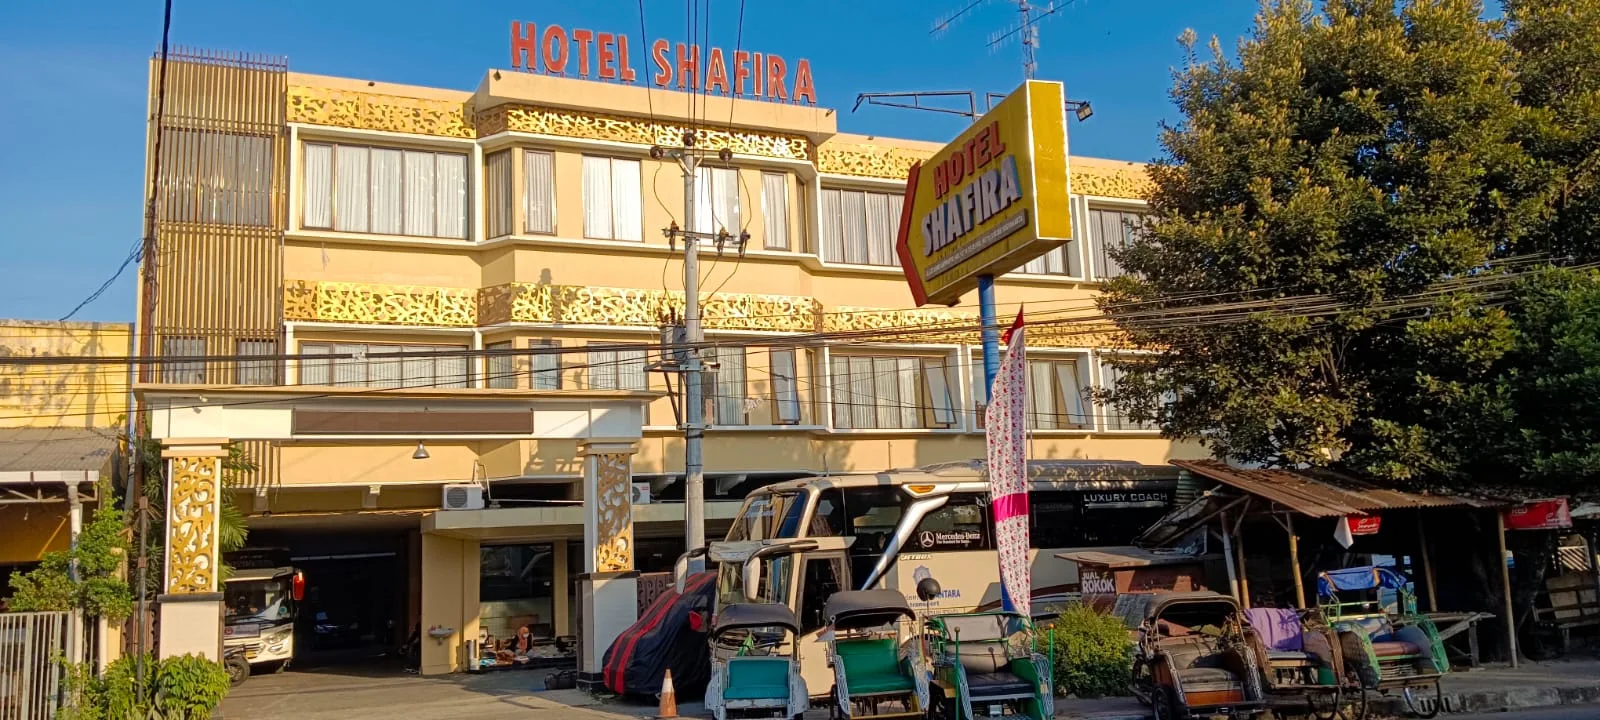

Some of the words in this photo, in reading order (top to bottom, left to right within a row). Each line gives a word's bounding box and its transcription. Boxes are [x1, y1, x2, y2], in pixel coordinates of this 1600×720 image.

[511, 20, 636, 82] HOTEL
[652, 38, 817, 104] SHAFIRA
[933, 120, 1006, 199] HOTEL
[921, 154, 1022, 256] SHAFIRA
[1083, 493, 1127, 502] LUXURY
[1130, 493, 1168, 501] COACH
[1081, 571, 1100, 580] JUAL
[1082, 579, 1115, 594] ROKOK
